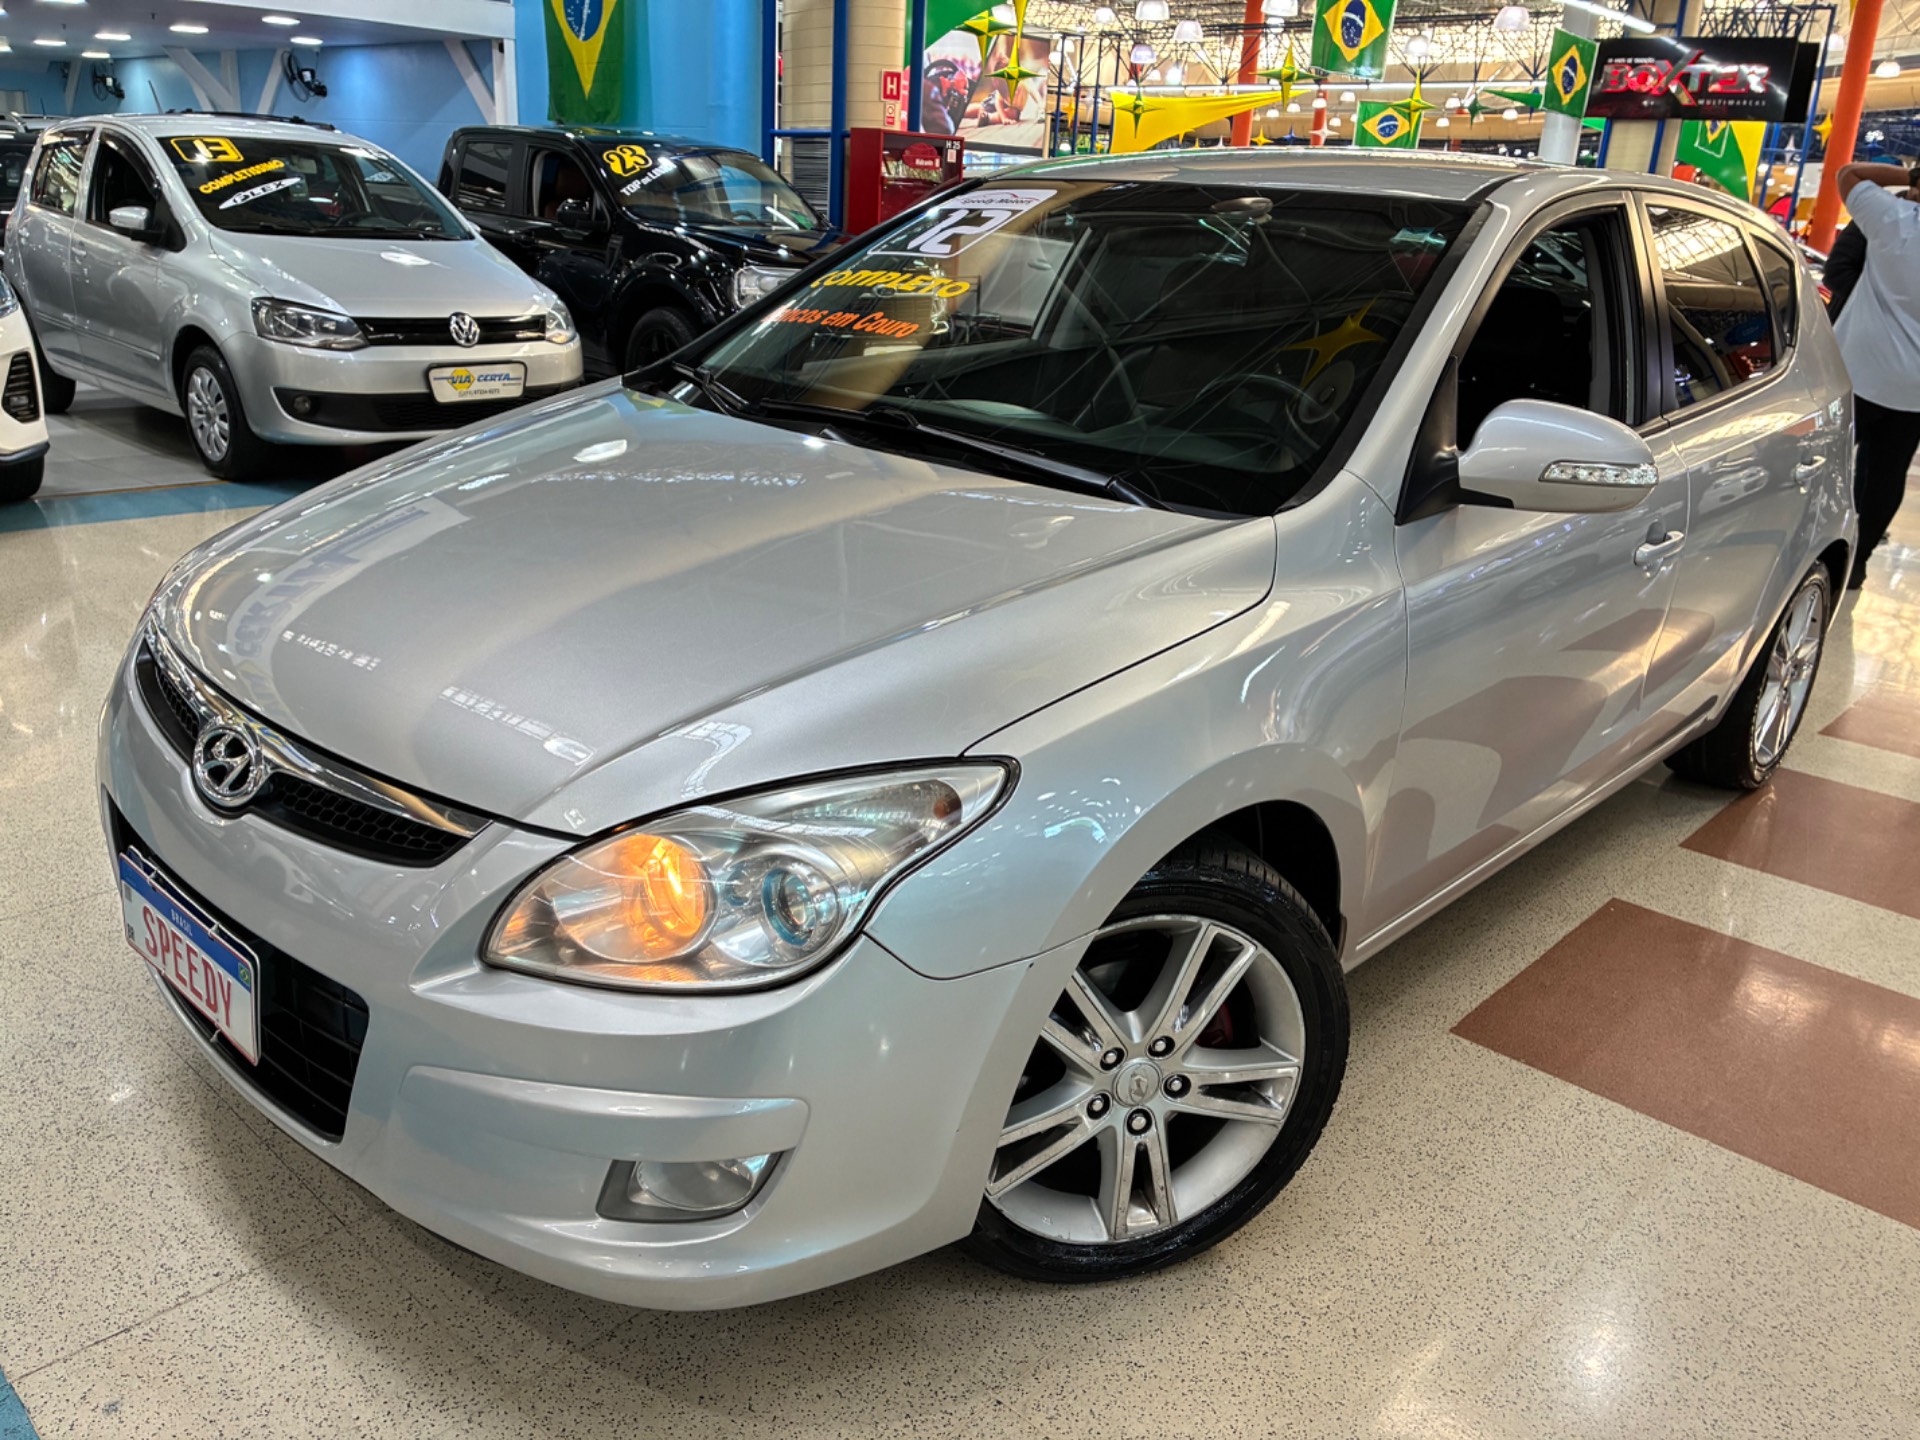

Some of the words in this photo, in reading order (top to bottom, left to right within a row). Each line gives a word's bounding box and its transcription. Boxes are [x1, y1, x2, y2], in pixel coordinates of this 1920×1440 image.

[886, 76, 898, 96] H
[1602, 50, 1771, 107] BOXTER
[603, 145, 652, 177] 23
[620, 179, 641, 196] TOP
[907, 208, 1012, 254] 12
[811, 269, 971, 298] COMPLETO
[760, 305, 829, 324] ncos
[820, 311, 860, 328] em
[852, 311, 920, 339] Couro
[450, 375, 472, 384] VIA
[476, 373, 511, 382] CERTA
[170, 909, 193, 936] BRASIL
[143, 905, 232, 1028] SPEEDY
